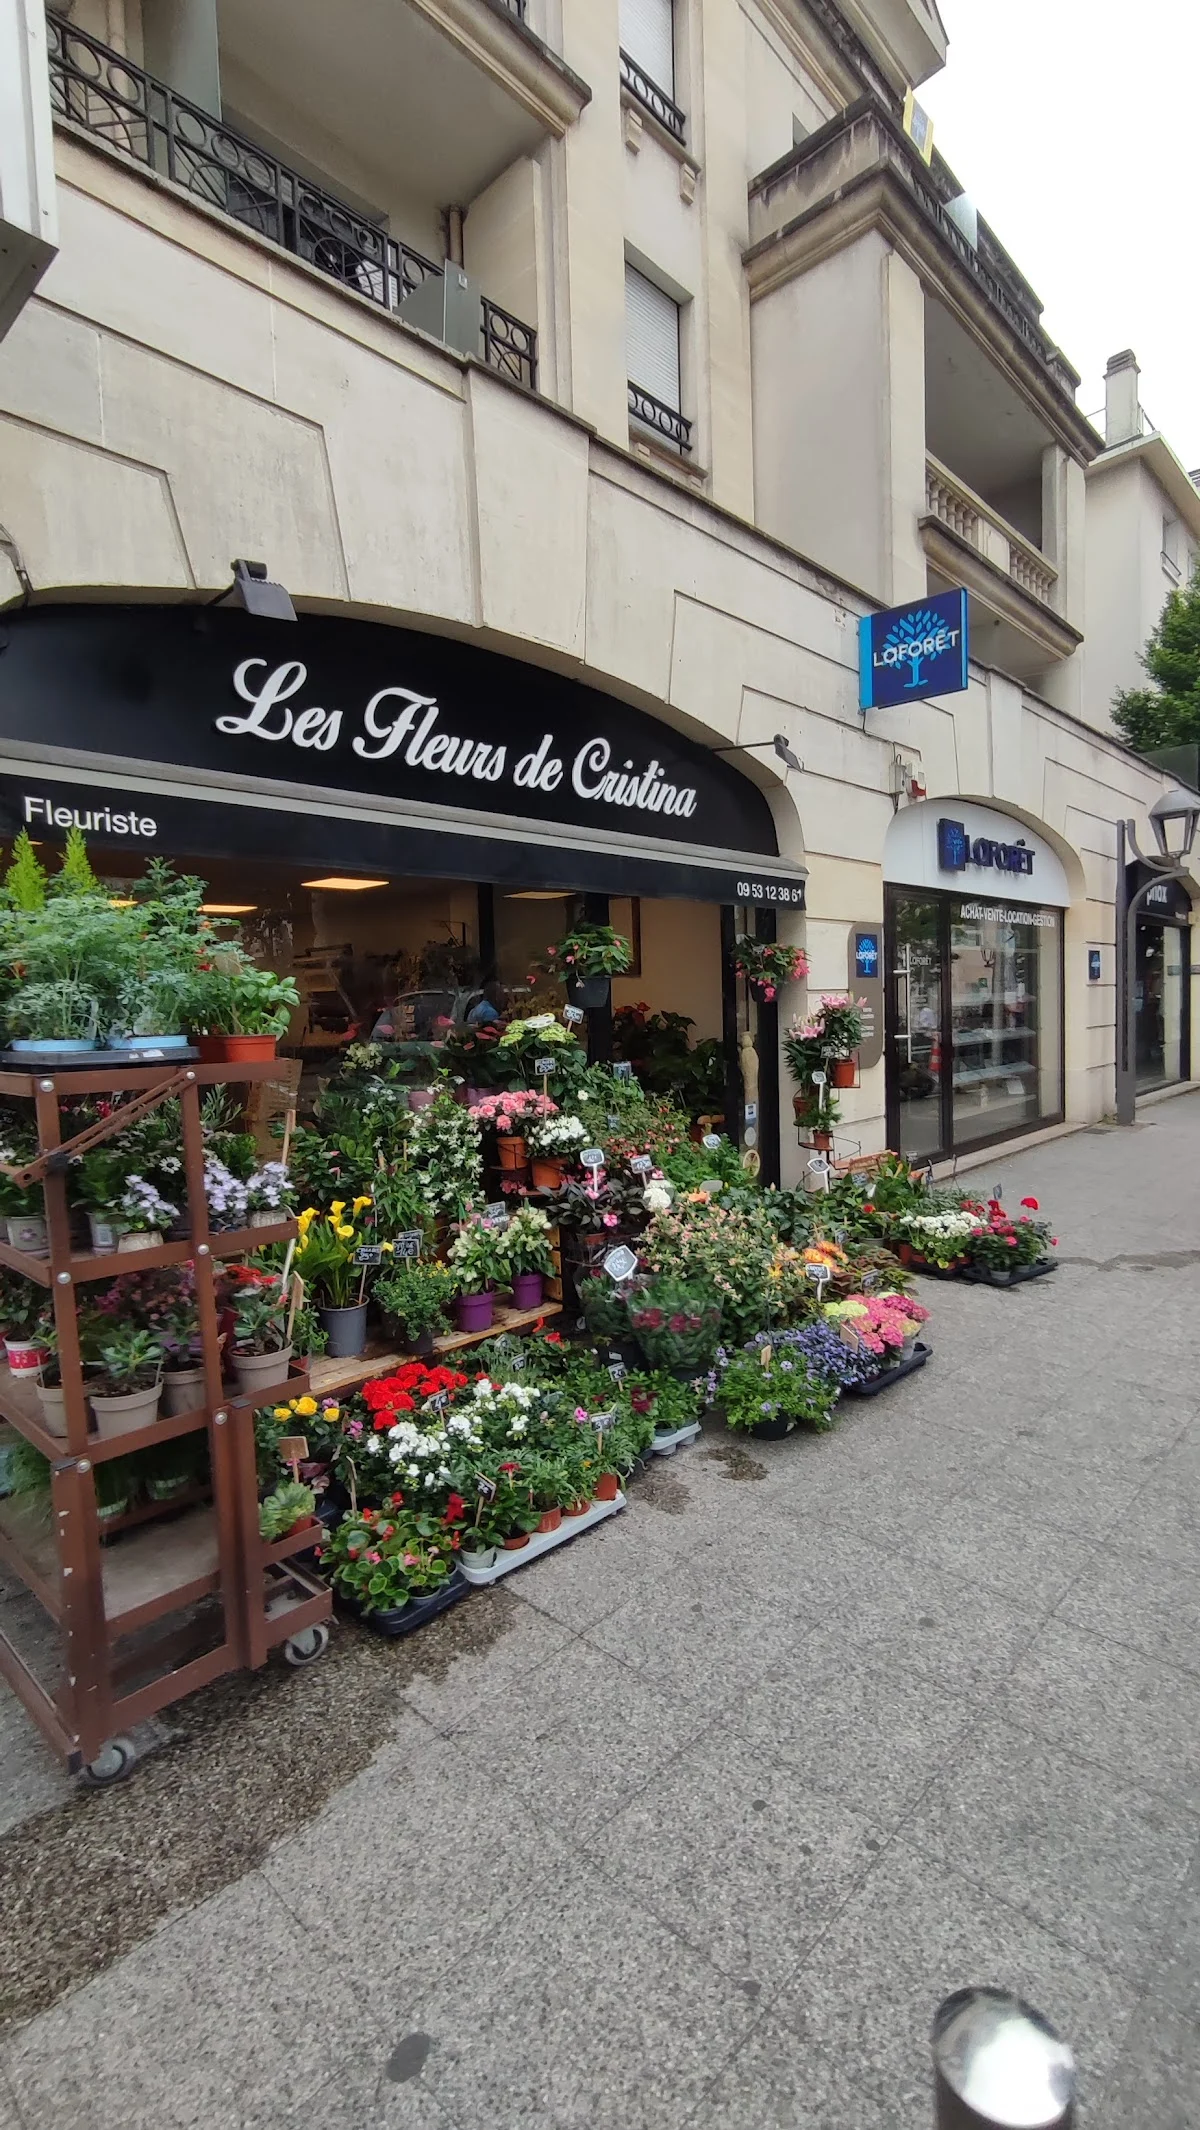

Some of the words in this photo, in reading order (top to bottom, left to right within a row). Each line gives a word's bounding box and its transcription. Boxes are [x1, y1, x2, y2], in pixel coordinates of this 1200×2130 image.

[215, 658, 344, 751] Les
[352, 686, 507, 782] Fleurs
[513, 734, 565, 792] de
[571, 736, 699, 818] Cristina
[23, 796, 157, 837] Fleuriste
[736, 881, 750, 897] 09
[751, 883, 764, 899] 53
[765, 885, 777, 900] 12
[778, 886, 790, 902] 38
[791, 888, 802, 903] 61
